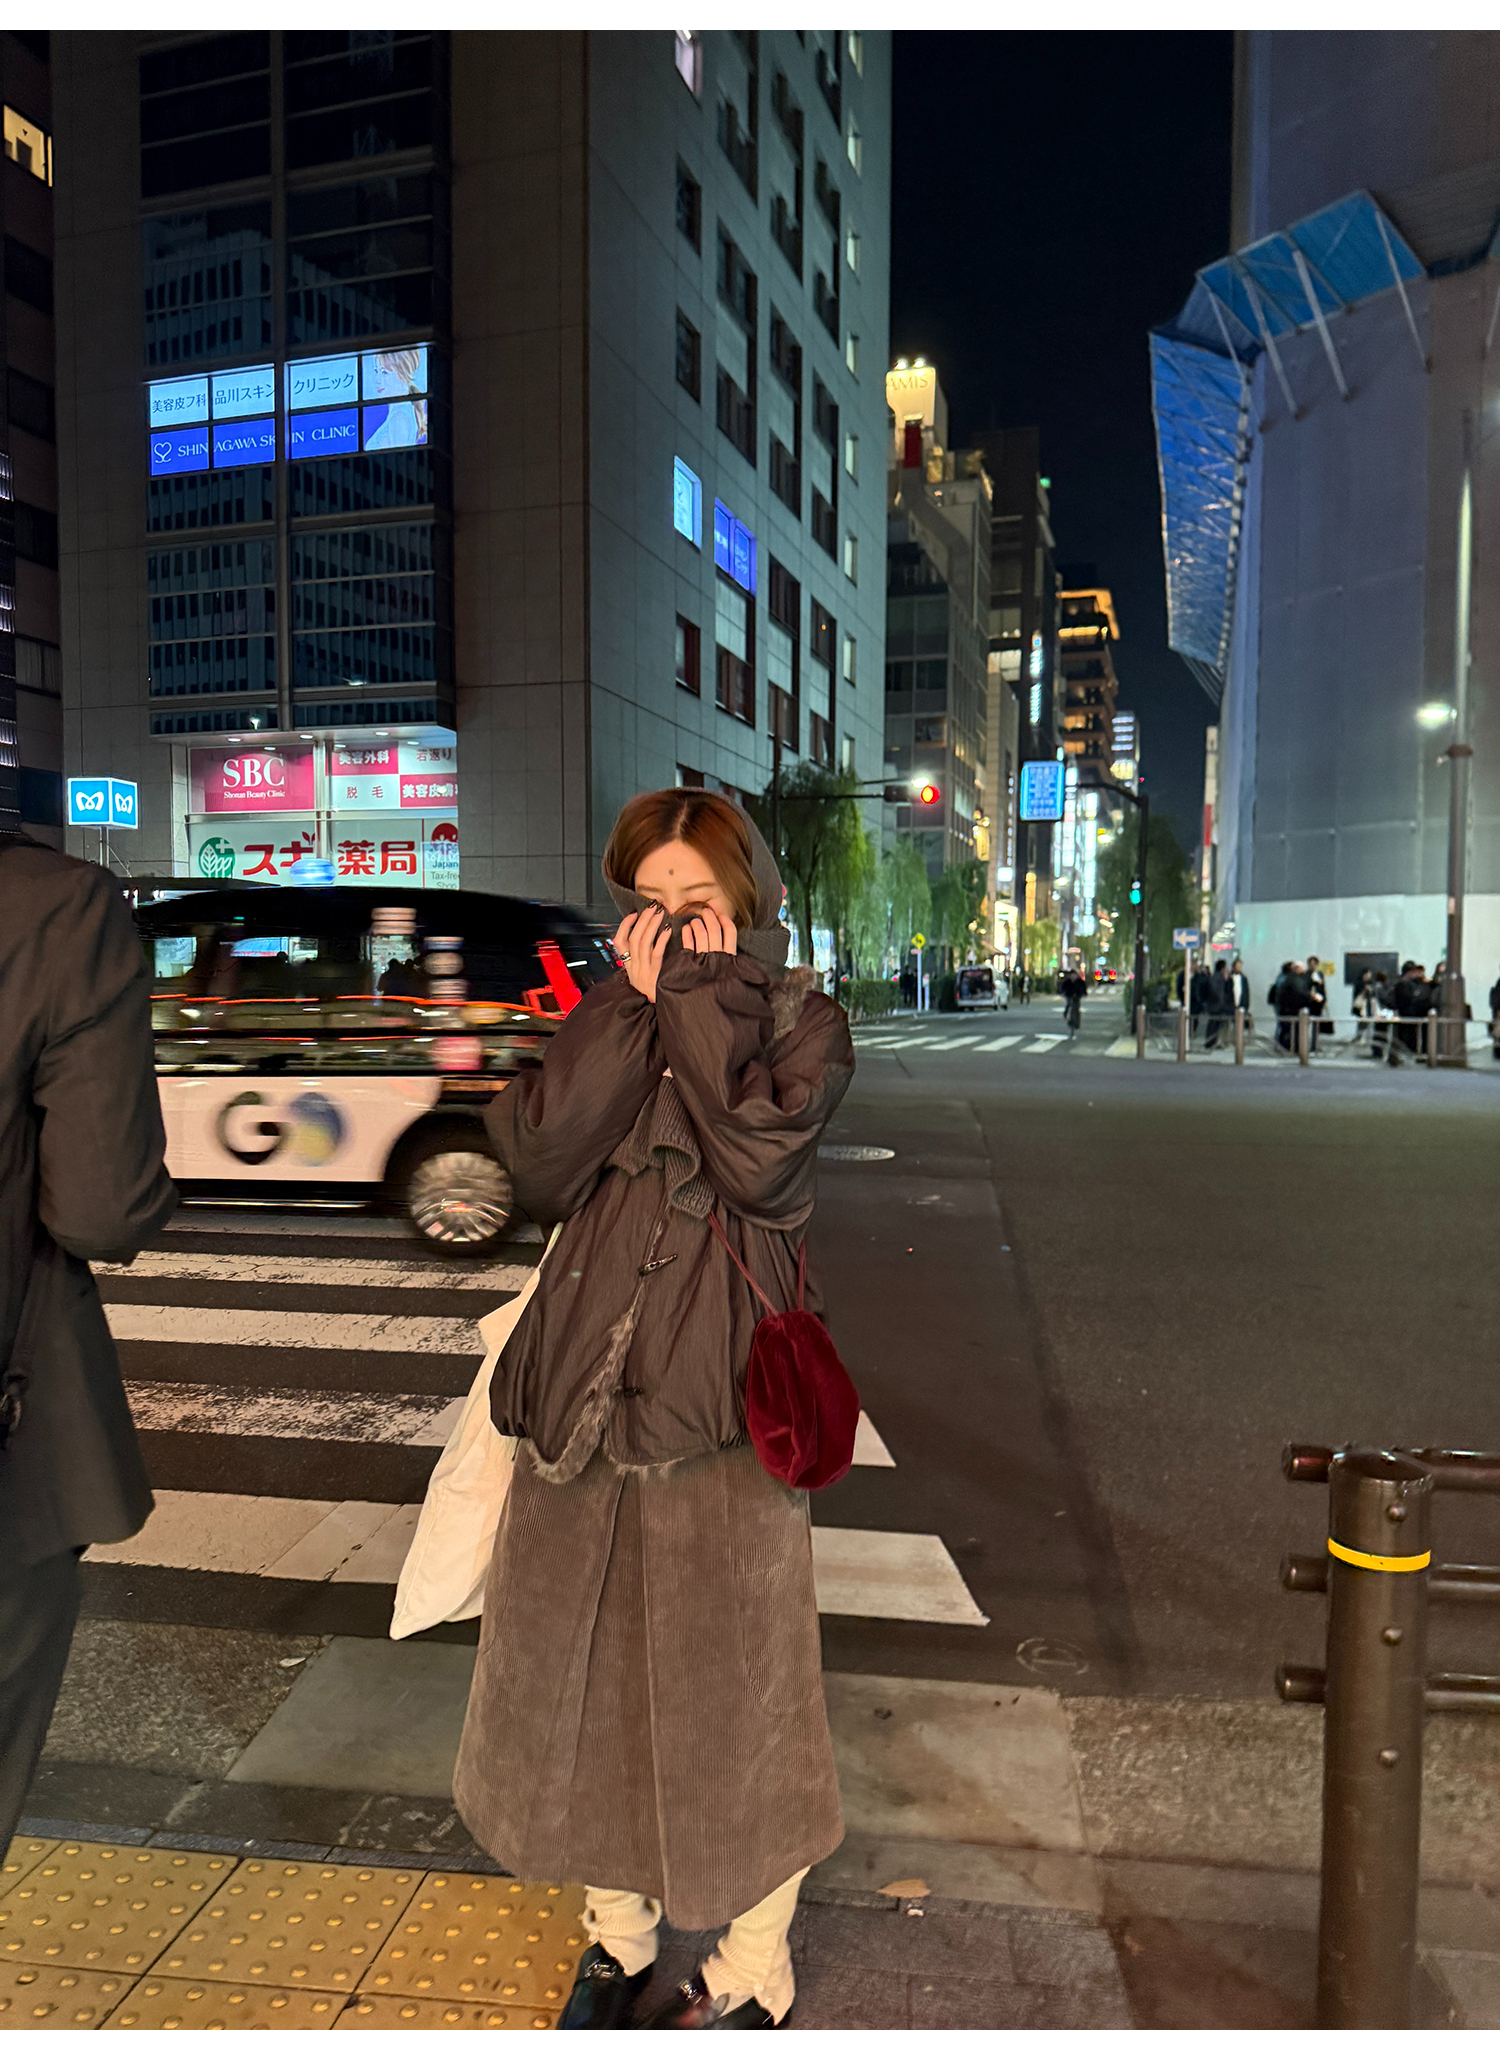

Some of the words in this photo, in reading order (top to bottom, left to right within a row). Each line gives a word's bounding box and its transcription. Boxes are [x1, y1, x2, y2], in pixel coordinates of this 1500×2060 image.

[152, 393, 206, 413] 美容皮フ科
[312, 424, 355, 441] CLINIC
[339, 750, 389, 765] 美容外科
[223, 757, 285, 788] SBC
[223, 791, 246, 799] Shonan
[246, 790, 266, 800] Beauty
[267, 790, 285, 798] Clinic
[402, 783, 458, 798] 美容皮膚
[432, 860, 459, 870] Japan
